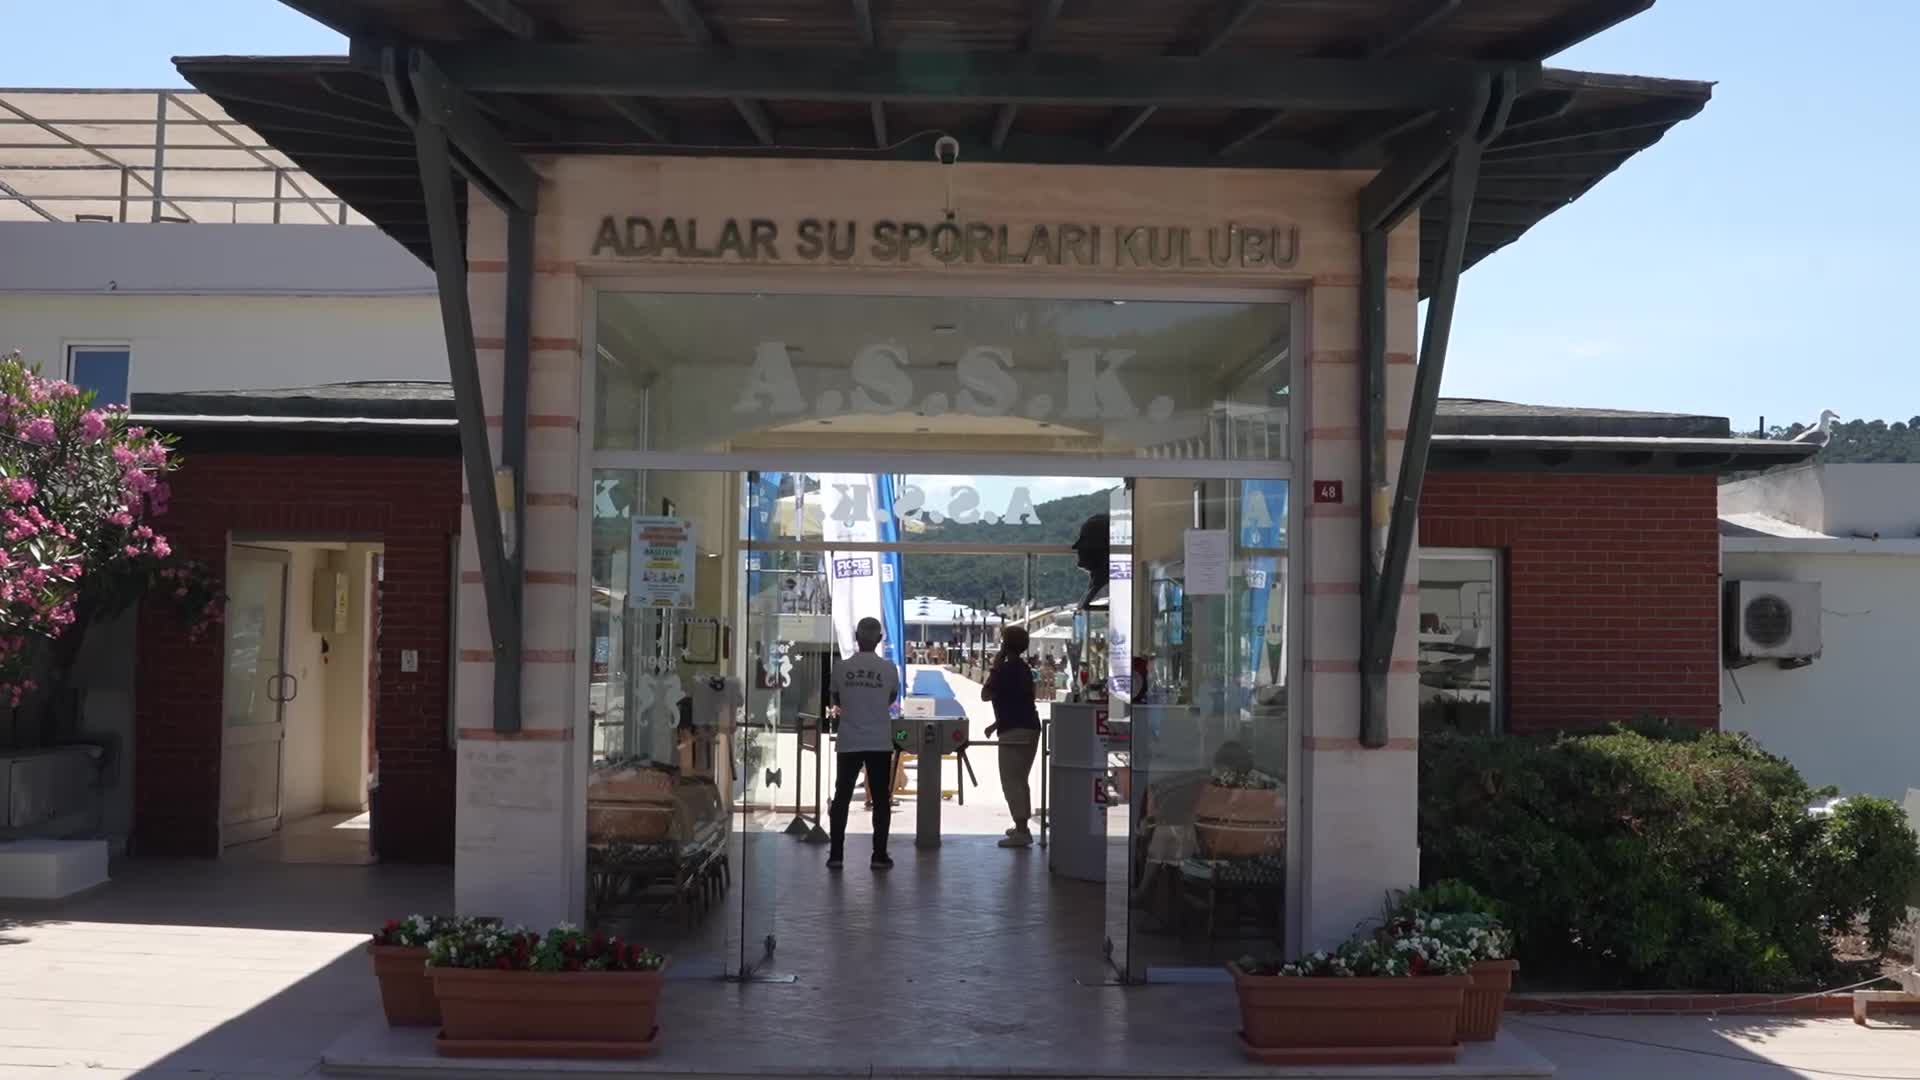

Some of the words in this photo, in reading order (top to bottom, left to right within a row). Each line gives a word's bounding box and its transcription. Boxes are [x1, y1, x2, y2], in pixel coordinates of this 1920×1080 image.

[592, 214, 780, 260] ADALAR
[794, 219, 857, 260] SU
[870, 219, 1100, 265] SPORLARI
[733, 341, 1176, 422] A.S.S.K.
[1321, 485, 1336, 498] 48
